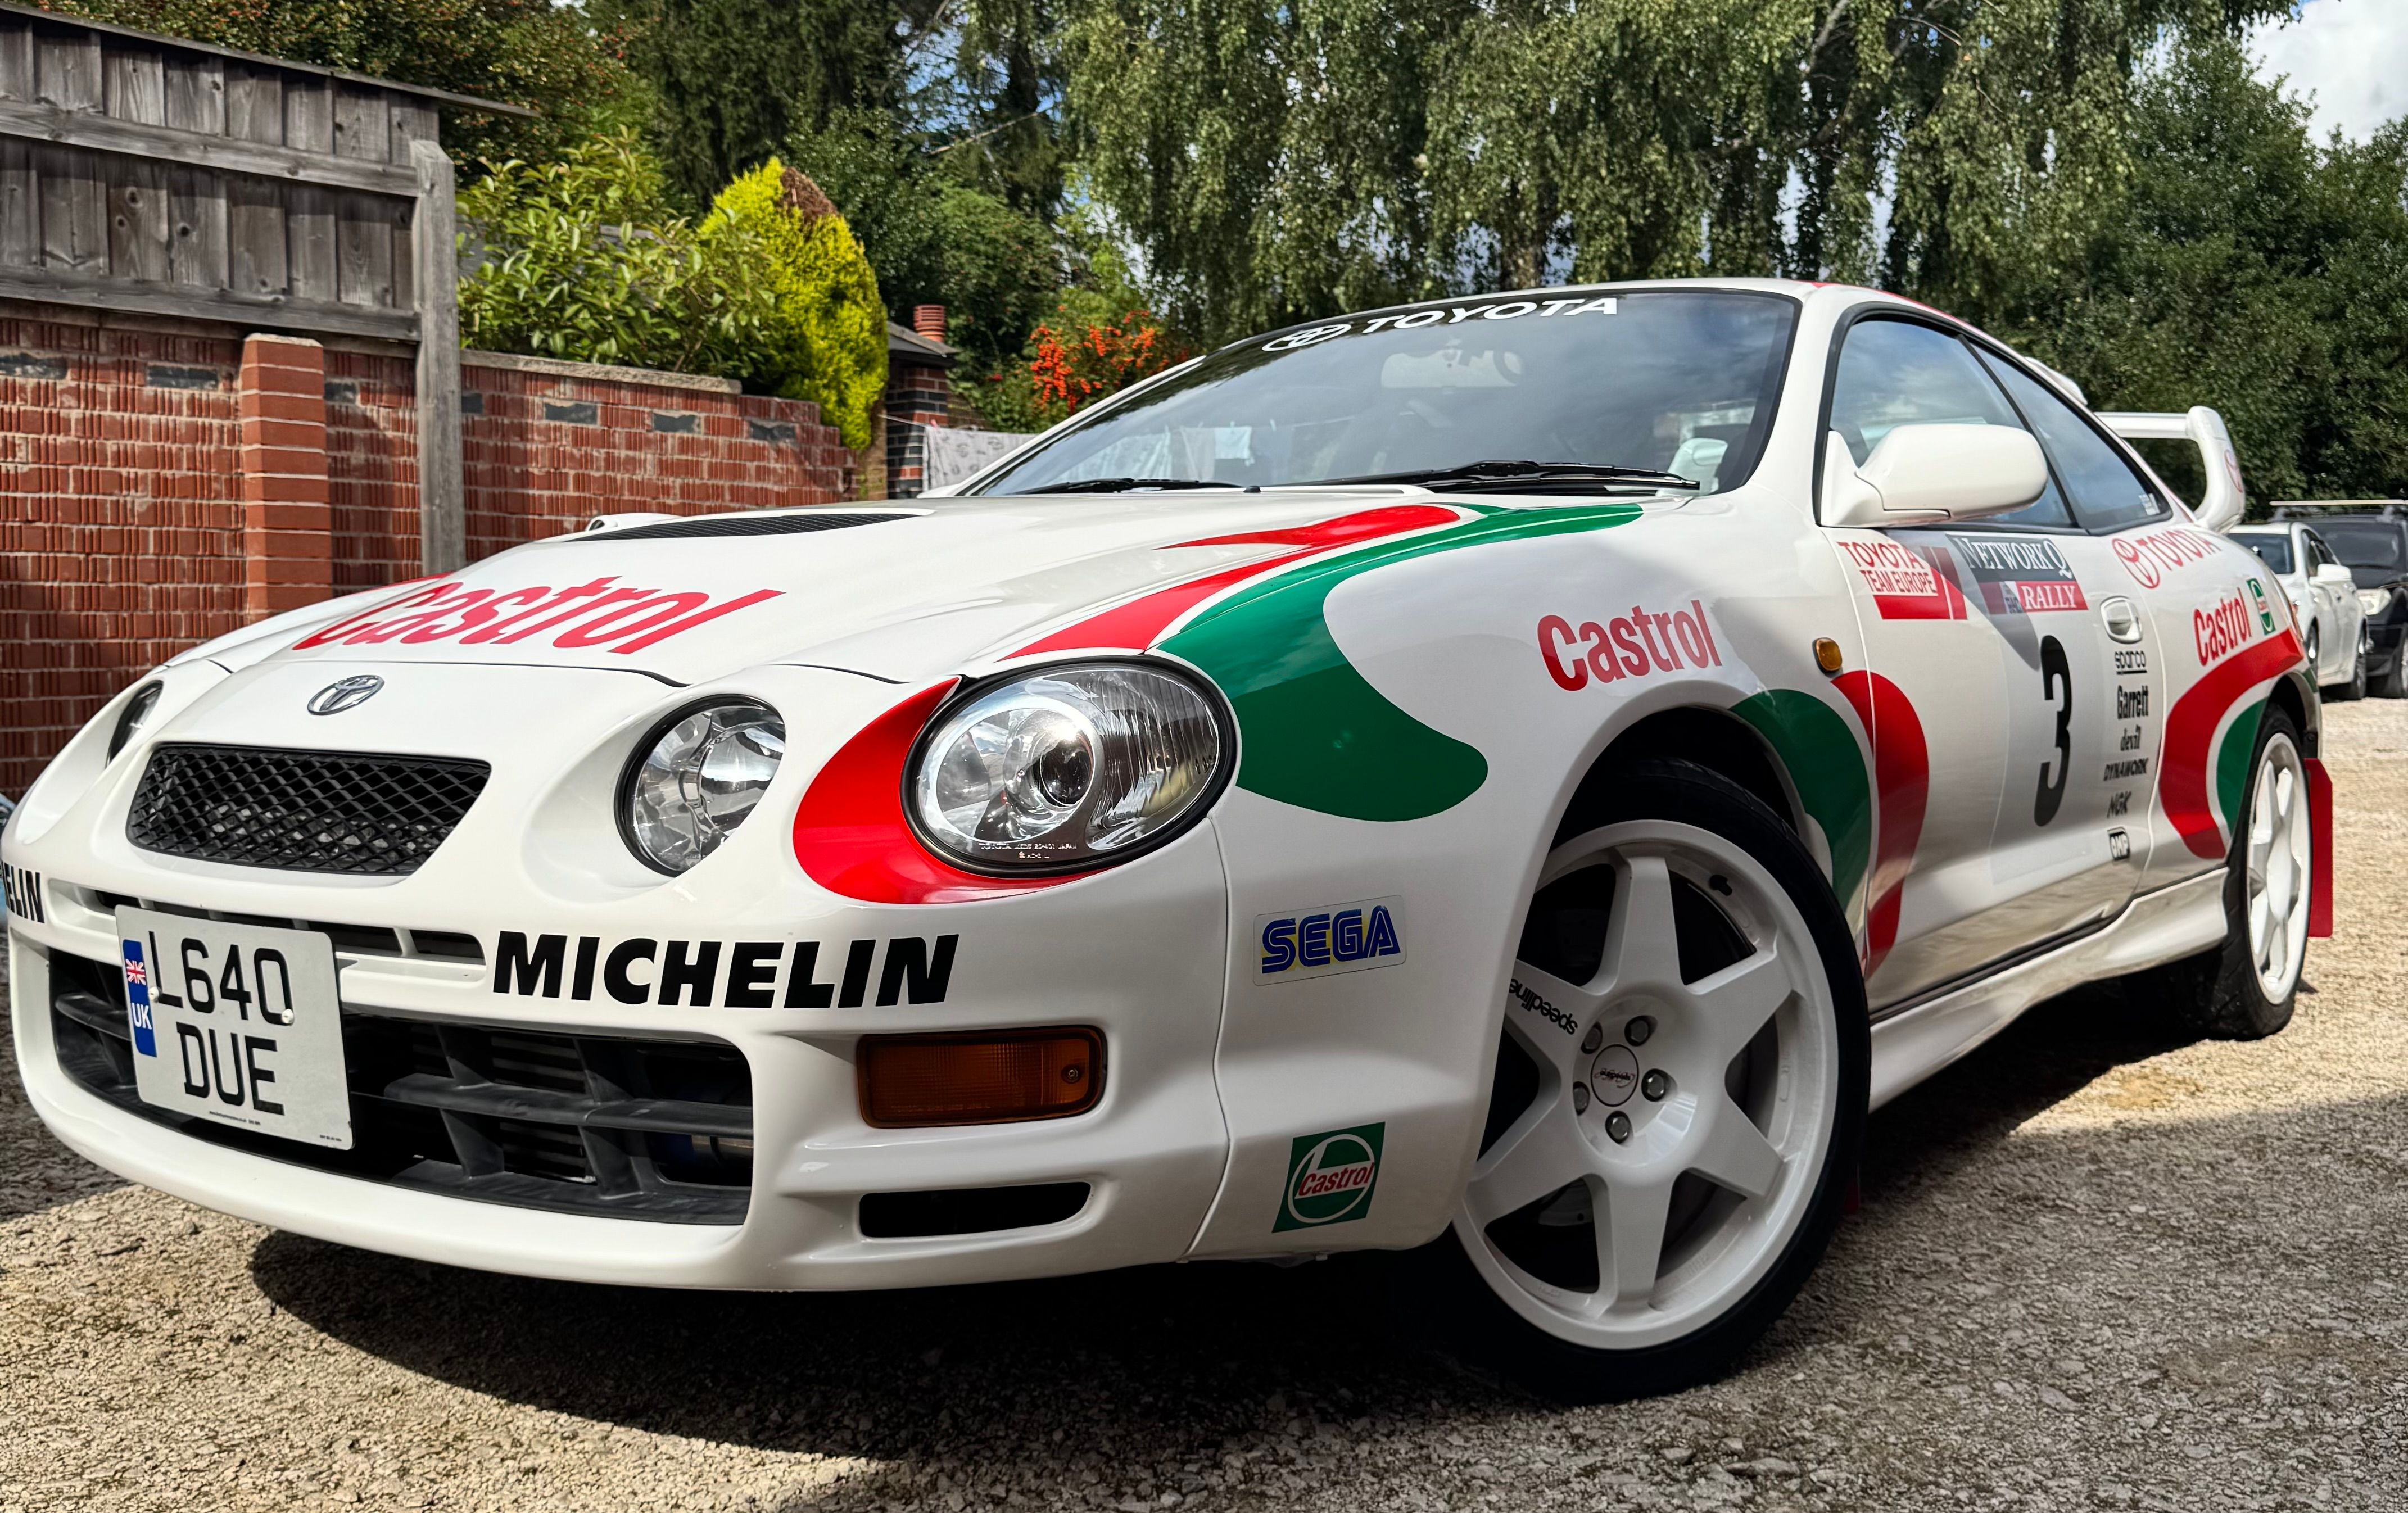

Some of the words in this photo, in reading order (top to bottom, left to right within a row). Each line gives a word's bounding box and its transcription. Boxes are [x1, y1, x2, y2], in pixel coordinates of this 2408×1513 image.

[1362, 297, 1617, 334] TOYOTA
[1836, 542, 1925, 569] TOYOTA
[1953, 537, 2053, 570] NETWORK
[2135, 529, 2222, 571] TOYOTA
[1859, 570, 1897, 592] TEAM
[1890, 571, 1937, 593] EUROPE
[2021, 585, 2077, 610] RALLY
[292, 576, 787, 654] Castrol
[2194, 587, 2252, 667] Castrol
[1537, 599, 1723, 691] Castrol
[2114, 650, 2147, 669] sparco
[2117, 685, 2149, 719] Garrett
[2034, 635, 2072, 827] 3
[2120, 724, 2141, 751] devil
[2107, 791, 2131, 818] NGK
[1261, 905, 1401, 974] SEGA
[148, 931, 294, 1026] L640
[492, 930, 959, 1009] MICHELIN
[131, 1002, 153, 1030] UK
[1509, 978, 1578, 1035] speedline
[176, 1021, 285, 1116] DUE
[1298, 1162, 1375, 1197] Castrol
